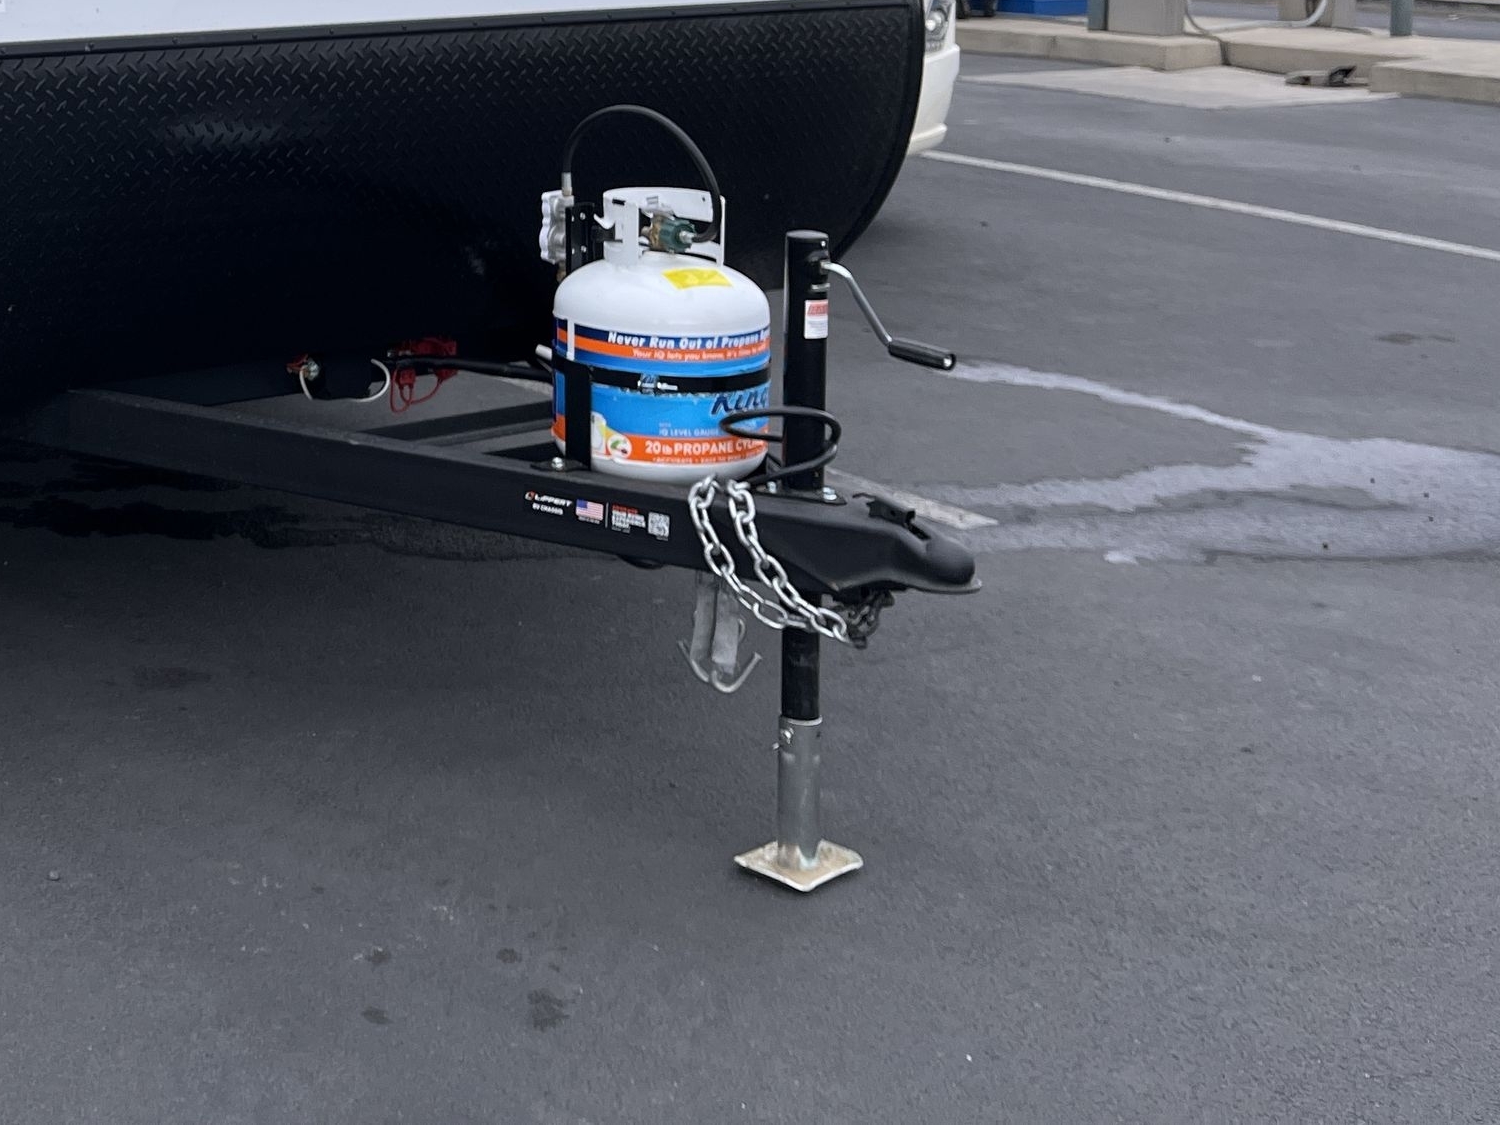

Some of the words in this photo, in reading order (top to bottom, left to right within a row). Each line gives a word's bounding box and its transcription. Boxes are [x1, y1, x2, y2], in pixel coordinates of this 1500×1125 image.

[608, 331, 645, 348] Never
[649, 336, 675, 349] Run
[679, 336, 702, 349] Out
[705, 336, 719, 349] of
[721, 332, 759, 350] Propane
[632, 349, 651, 359] Your
[666, 351, 682, 360] lets
[684, 352, 700, 362] you
[670, 428, 692, 437] LEVEL
[673, 439, 734, 456] PROPANE
